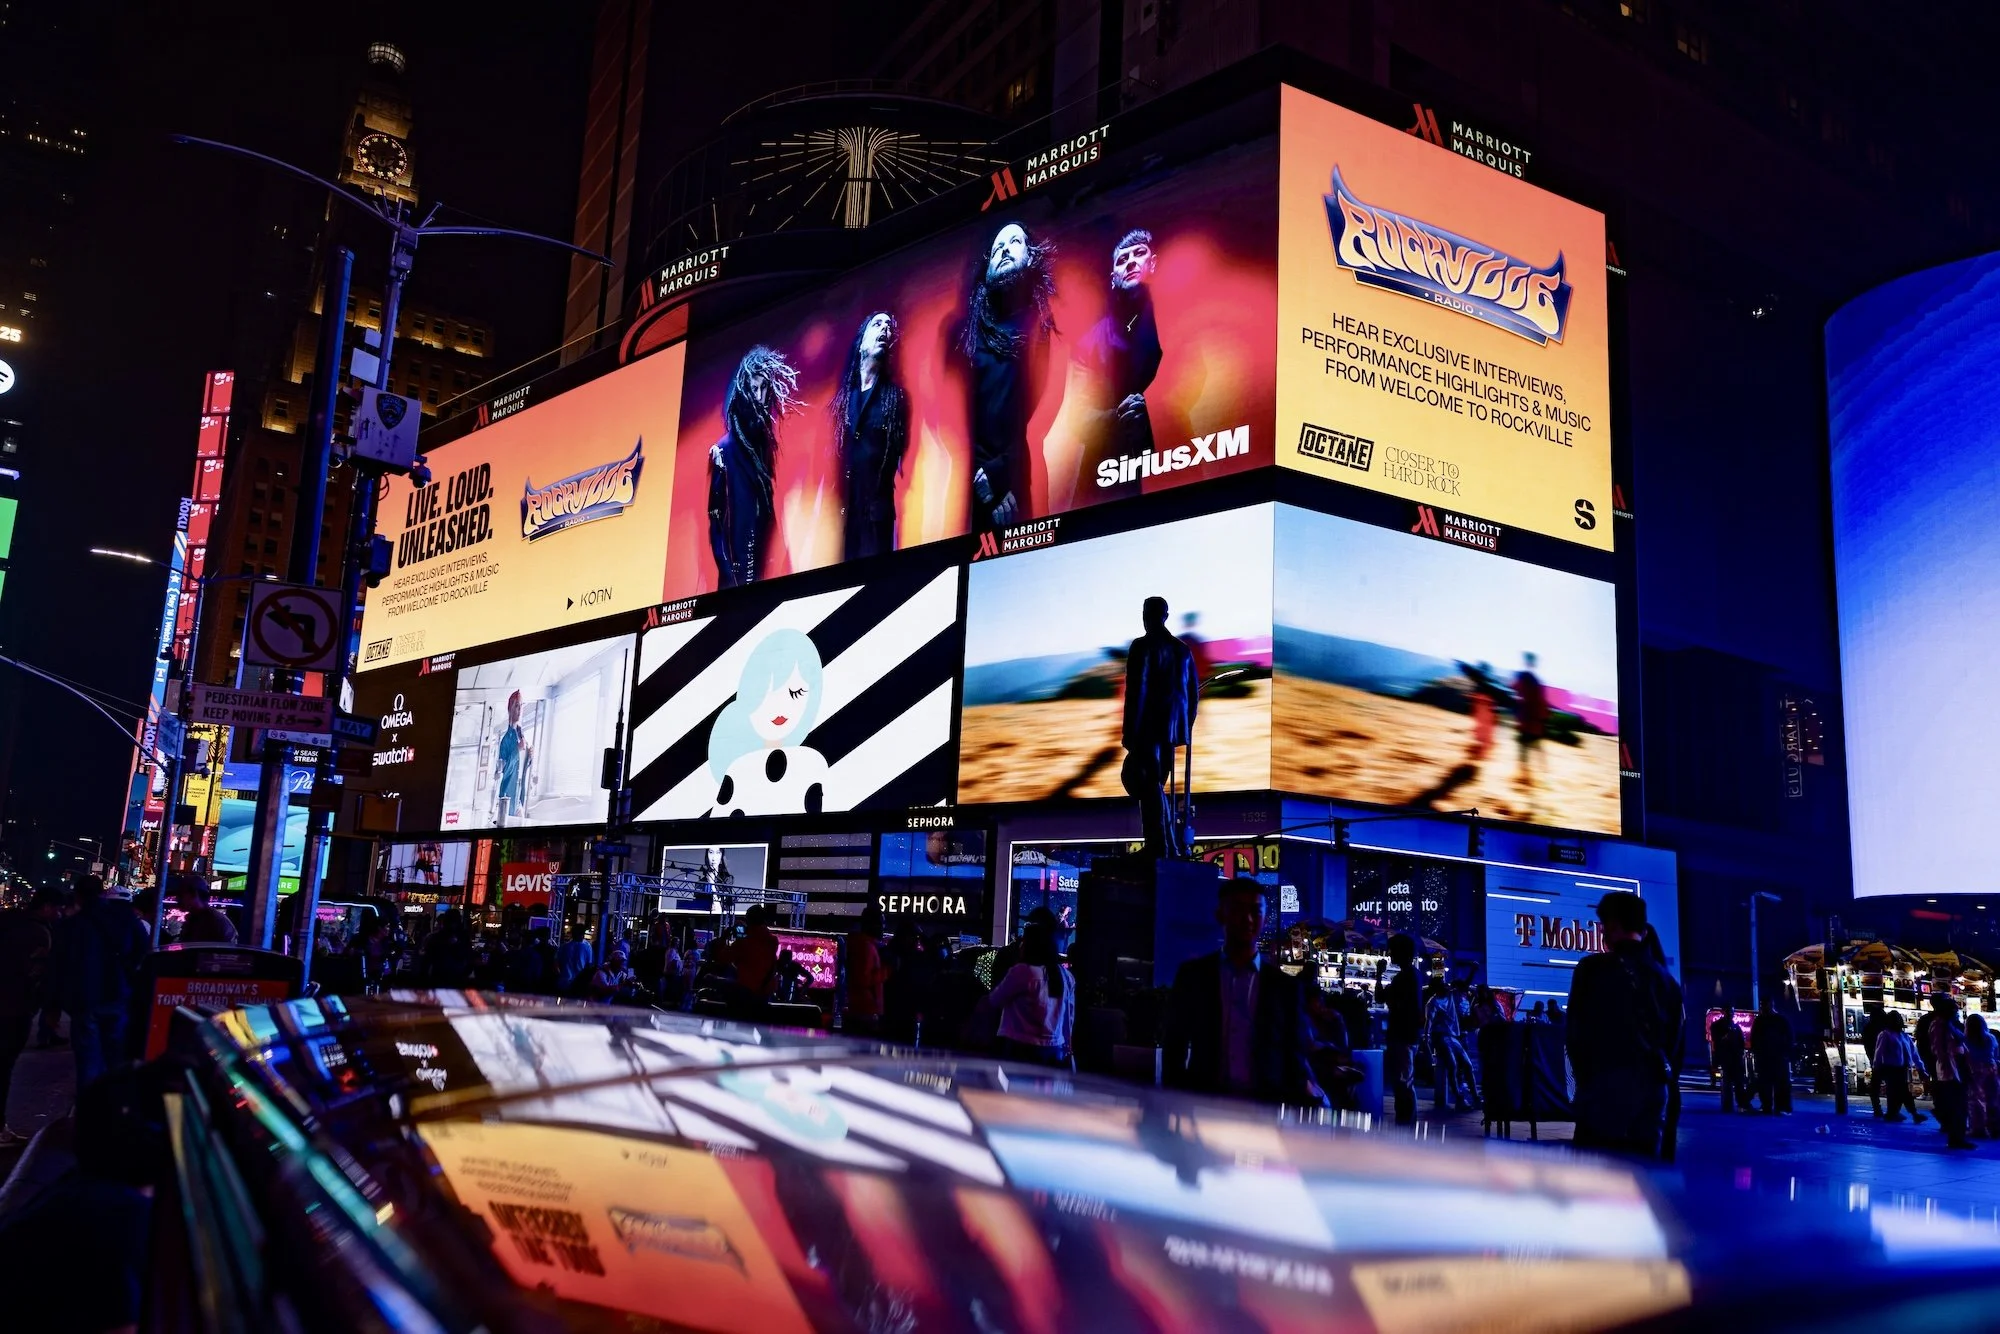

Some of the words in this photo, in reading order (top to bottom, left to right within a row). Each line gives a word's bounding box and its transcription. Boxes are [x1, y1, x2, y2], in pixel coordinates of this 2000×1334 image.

[1027, 124, 1110, 171] MARRIOTT
[1453, 120, 1531, 164] MARRIOTT
[1025, 146, 1099, 188] MARQUIS
[1453, 138, 1523, 178] MARQUIS
[661, 246, 729, 282] MARRIOTT
[1338, 190, 1561, 335] ROCKVILLE
[659, 265, 718, 298] MARQUIS
[1434, 294, 1474, 315] RADIO
[1332, 312, 1379, 343] HEAR
[1383, 324, 1470, 371] EXCLUSIVE
[1473, 358, 1567, 405] INTERVIEWS,
[1302, 327, 1432, 383] PERFORMANCE
[1436, 367, 1529, 413] HIGHLIGHTS
[1532, 401, 1542, 417] &
[1545, 405, 1592, 432] MUSIC
[493, 385, 530, 409] MARRIOTT
[1325, 358, 1376, 388] FROM
[1379, 373, 1464, 415] WELCOME
[1467, 400, 1488, 421] TO
[1491, 409, 1574, 448] ROCKVILLE
[492, 400, 524, 421] MARQUIS
[1096, 424, 1250, 488] SiriusXM
[1303, 428, 1369, 467] OCTANE
[1386, 446, 1436, 474] CLOSER
[1438, 459, 1460, 480] TO
[1384, 462, 1425, 488] HARD
[1427, 471, 1461, 497] ROCK
[405, 481, 442, 529] LIVE.
[445, 462, 494, 515] LOUD.
[524, 452, 638, 535] ROCKVILLE
[564, 514, 585, 528] RADIO
[1004, 518, 1060, 539] MARRIOTT
[1444, 514, 1501, 536] MARRIOTT
[397, 502, 494, 569] UNLEASHED.
[1003, 532, 1053, 551] MARQUIS
[1444, 527, 1496, 549] MARQUIS
[393, 573, 411, 590] HEAR
[411, 563, 446, 587] EXCLUSIVE
[446, 551, 489, 577] INTERVIEWS,
[381, 584, 429, 607] PERFORMANCE
[429, 572, 469, 596] HIGHLIGHTS
[469, 569, 476, 582] &
[476, 563, 500, 581] MUSIC
[387, 601, 406, 617] FROM
[406, 592, 439, 614] WELCOME
[440, 591, 449, 605] TO
[449, 580, 489, 604] ROCKVILLE
[662, 599, 697, 613] MARRIOTT
[661, 609, 692, 624] MARQUIS
[366, 641, 390, 660] OCTANE
[432, 653, 456, 665] MARRIOTT
[431, 661, 452, 673] MARQUIS
[205, 691, 268, 709] PEDESTRIAN
[270, 697, 298, 711] FLOW
[300, 699, 326, 714] ZONE
[203, 707, 230, 720] KEEP
[232, 709, 271, 724] MOVING
[381, 711, 413, 730] OMEGA
[339, 720, 369, 739] WAY
[372, 746, 408, 767] swatch
[907, 815, 954, 829] SEPHORA
[1387, 881, 1410, 895] eta
[878, 894, 967, 915] SEPHORA
[1352, 902, 1374, 912] our
[187, 981, 259, 996] BROADWAY'S
[157, 994, 187, 1007] TONY
[188, 995, 230, 1007] AWARD
